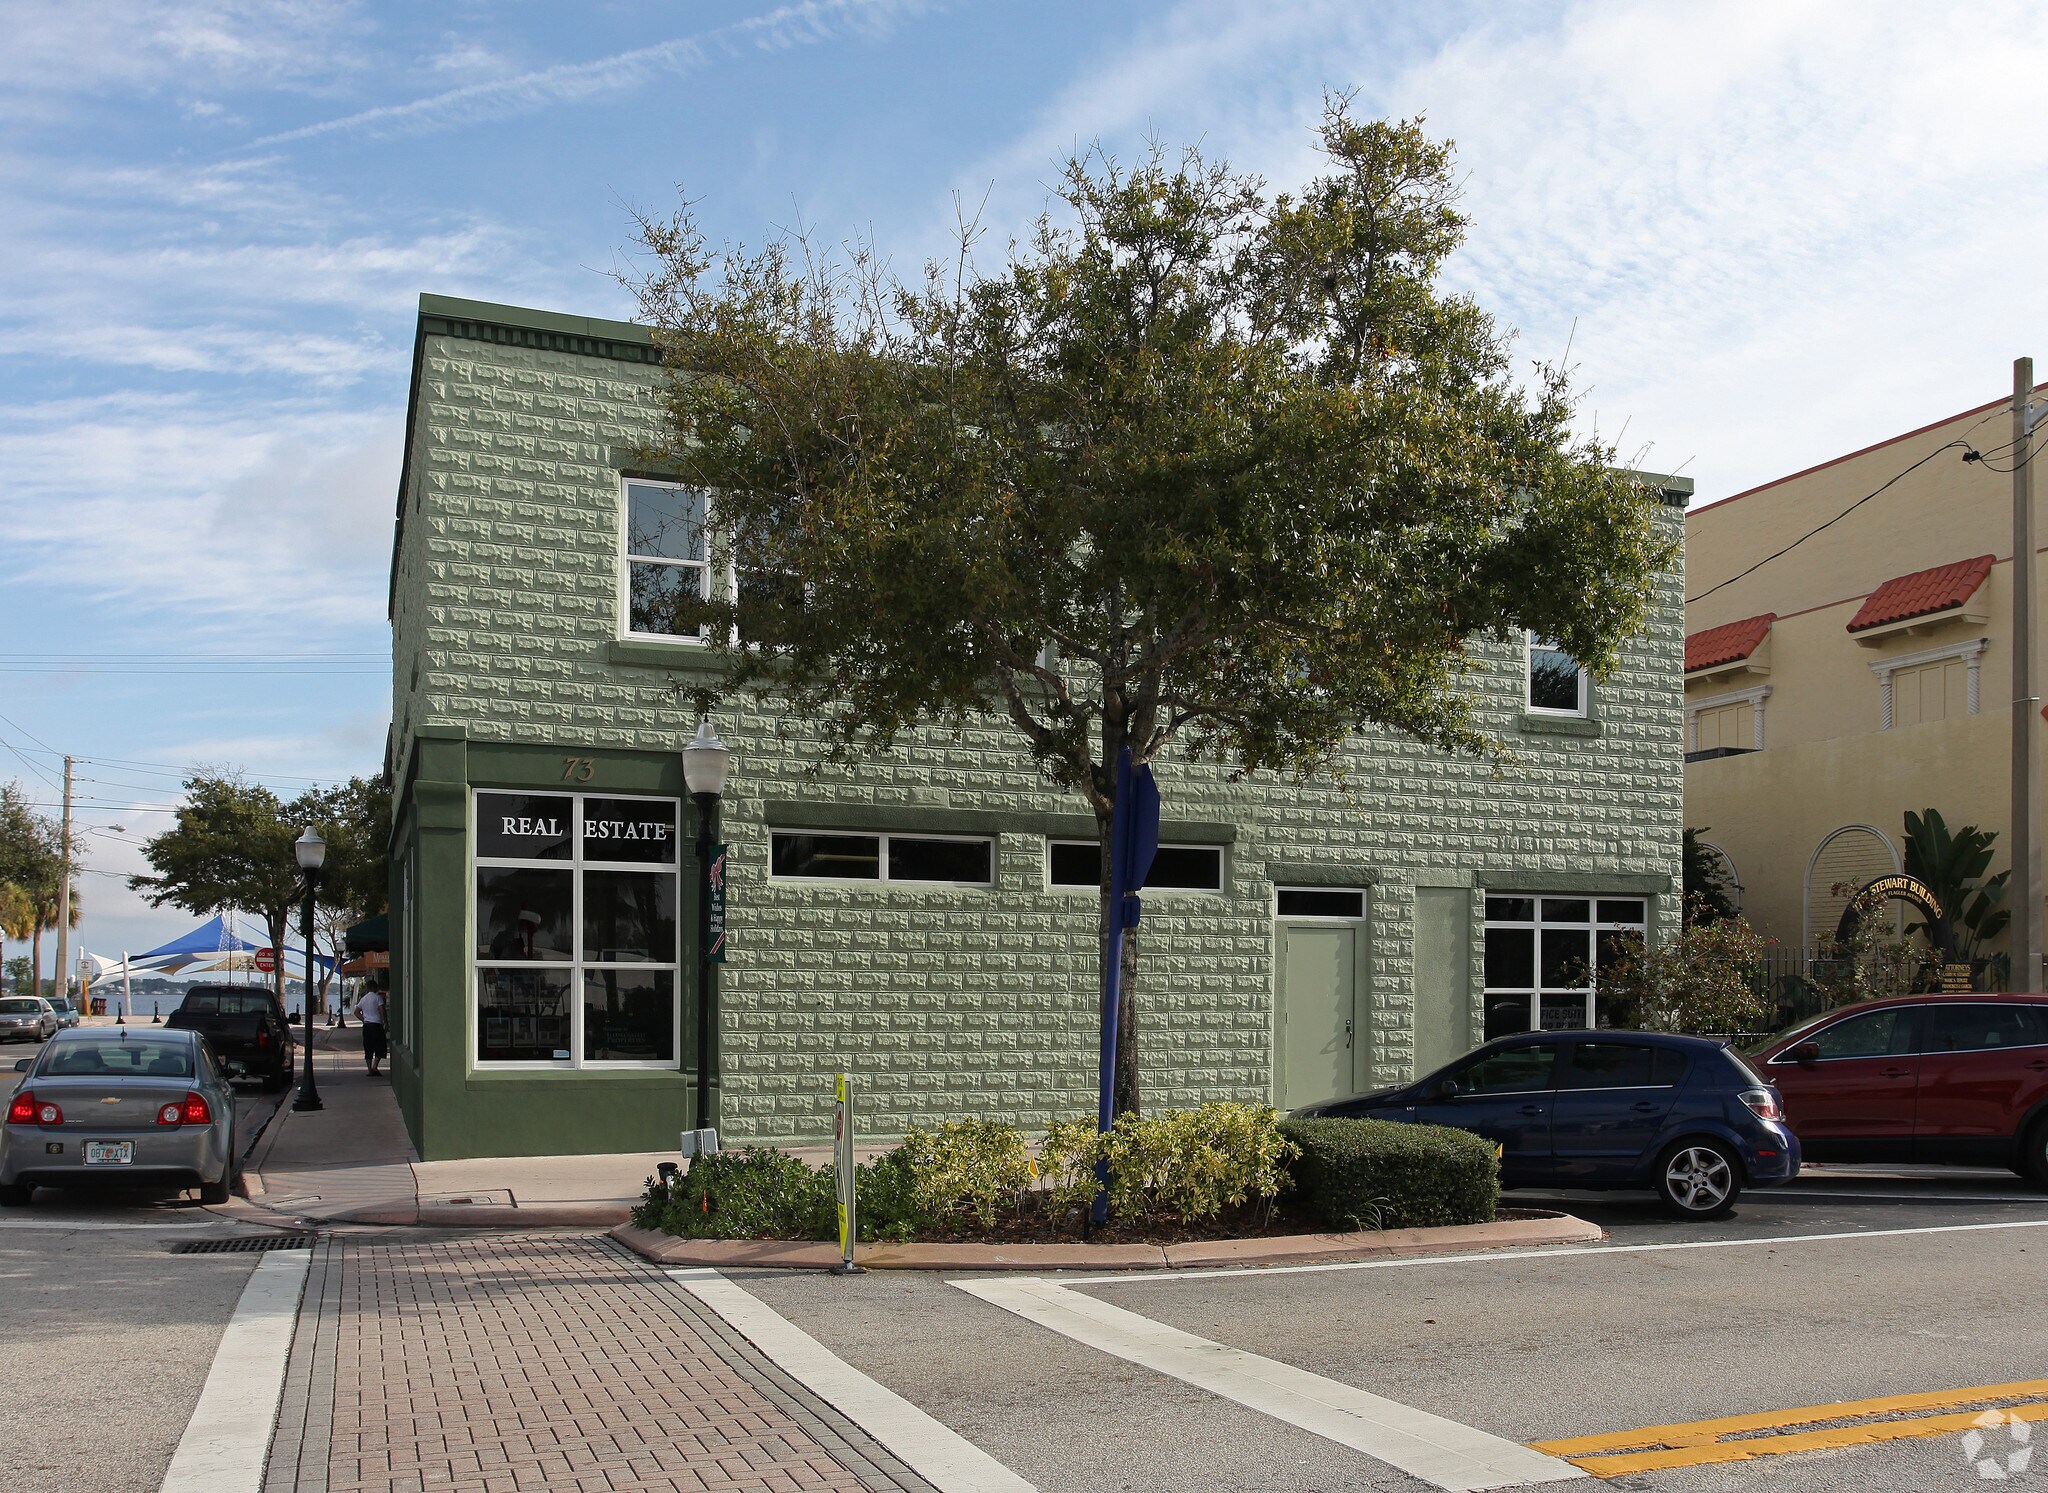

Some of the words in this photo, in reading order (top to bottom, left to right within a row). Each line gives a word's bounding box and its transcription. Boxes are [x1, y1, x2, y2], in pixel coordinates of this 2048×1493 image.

[563, 757, 597, 782] 73
[501, 816, 563, 837] REAL
[583, 820, 667, 841] ESTATE
[1871, 877, 1909, 894] STEWART
[1909, 880, 1944, 920] BUILDING
[1887, 889, 1907, 897] FLAGLER
[1945, 963, 1971, 971] ATTORNEYS
[1541, 1009, 1560, 1019] FICE
